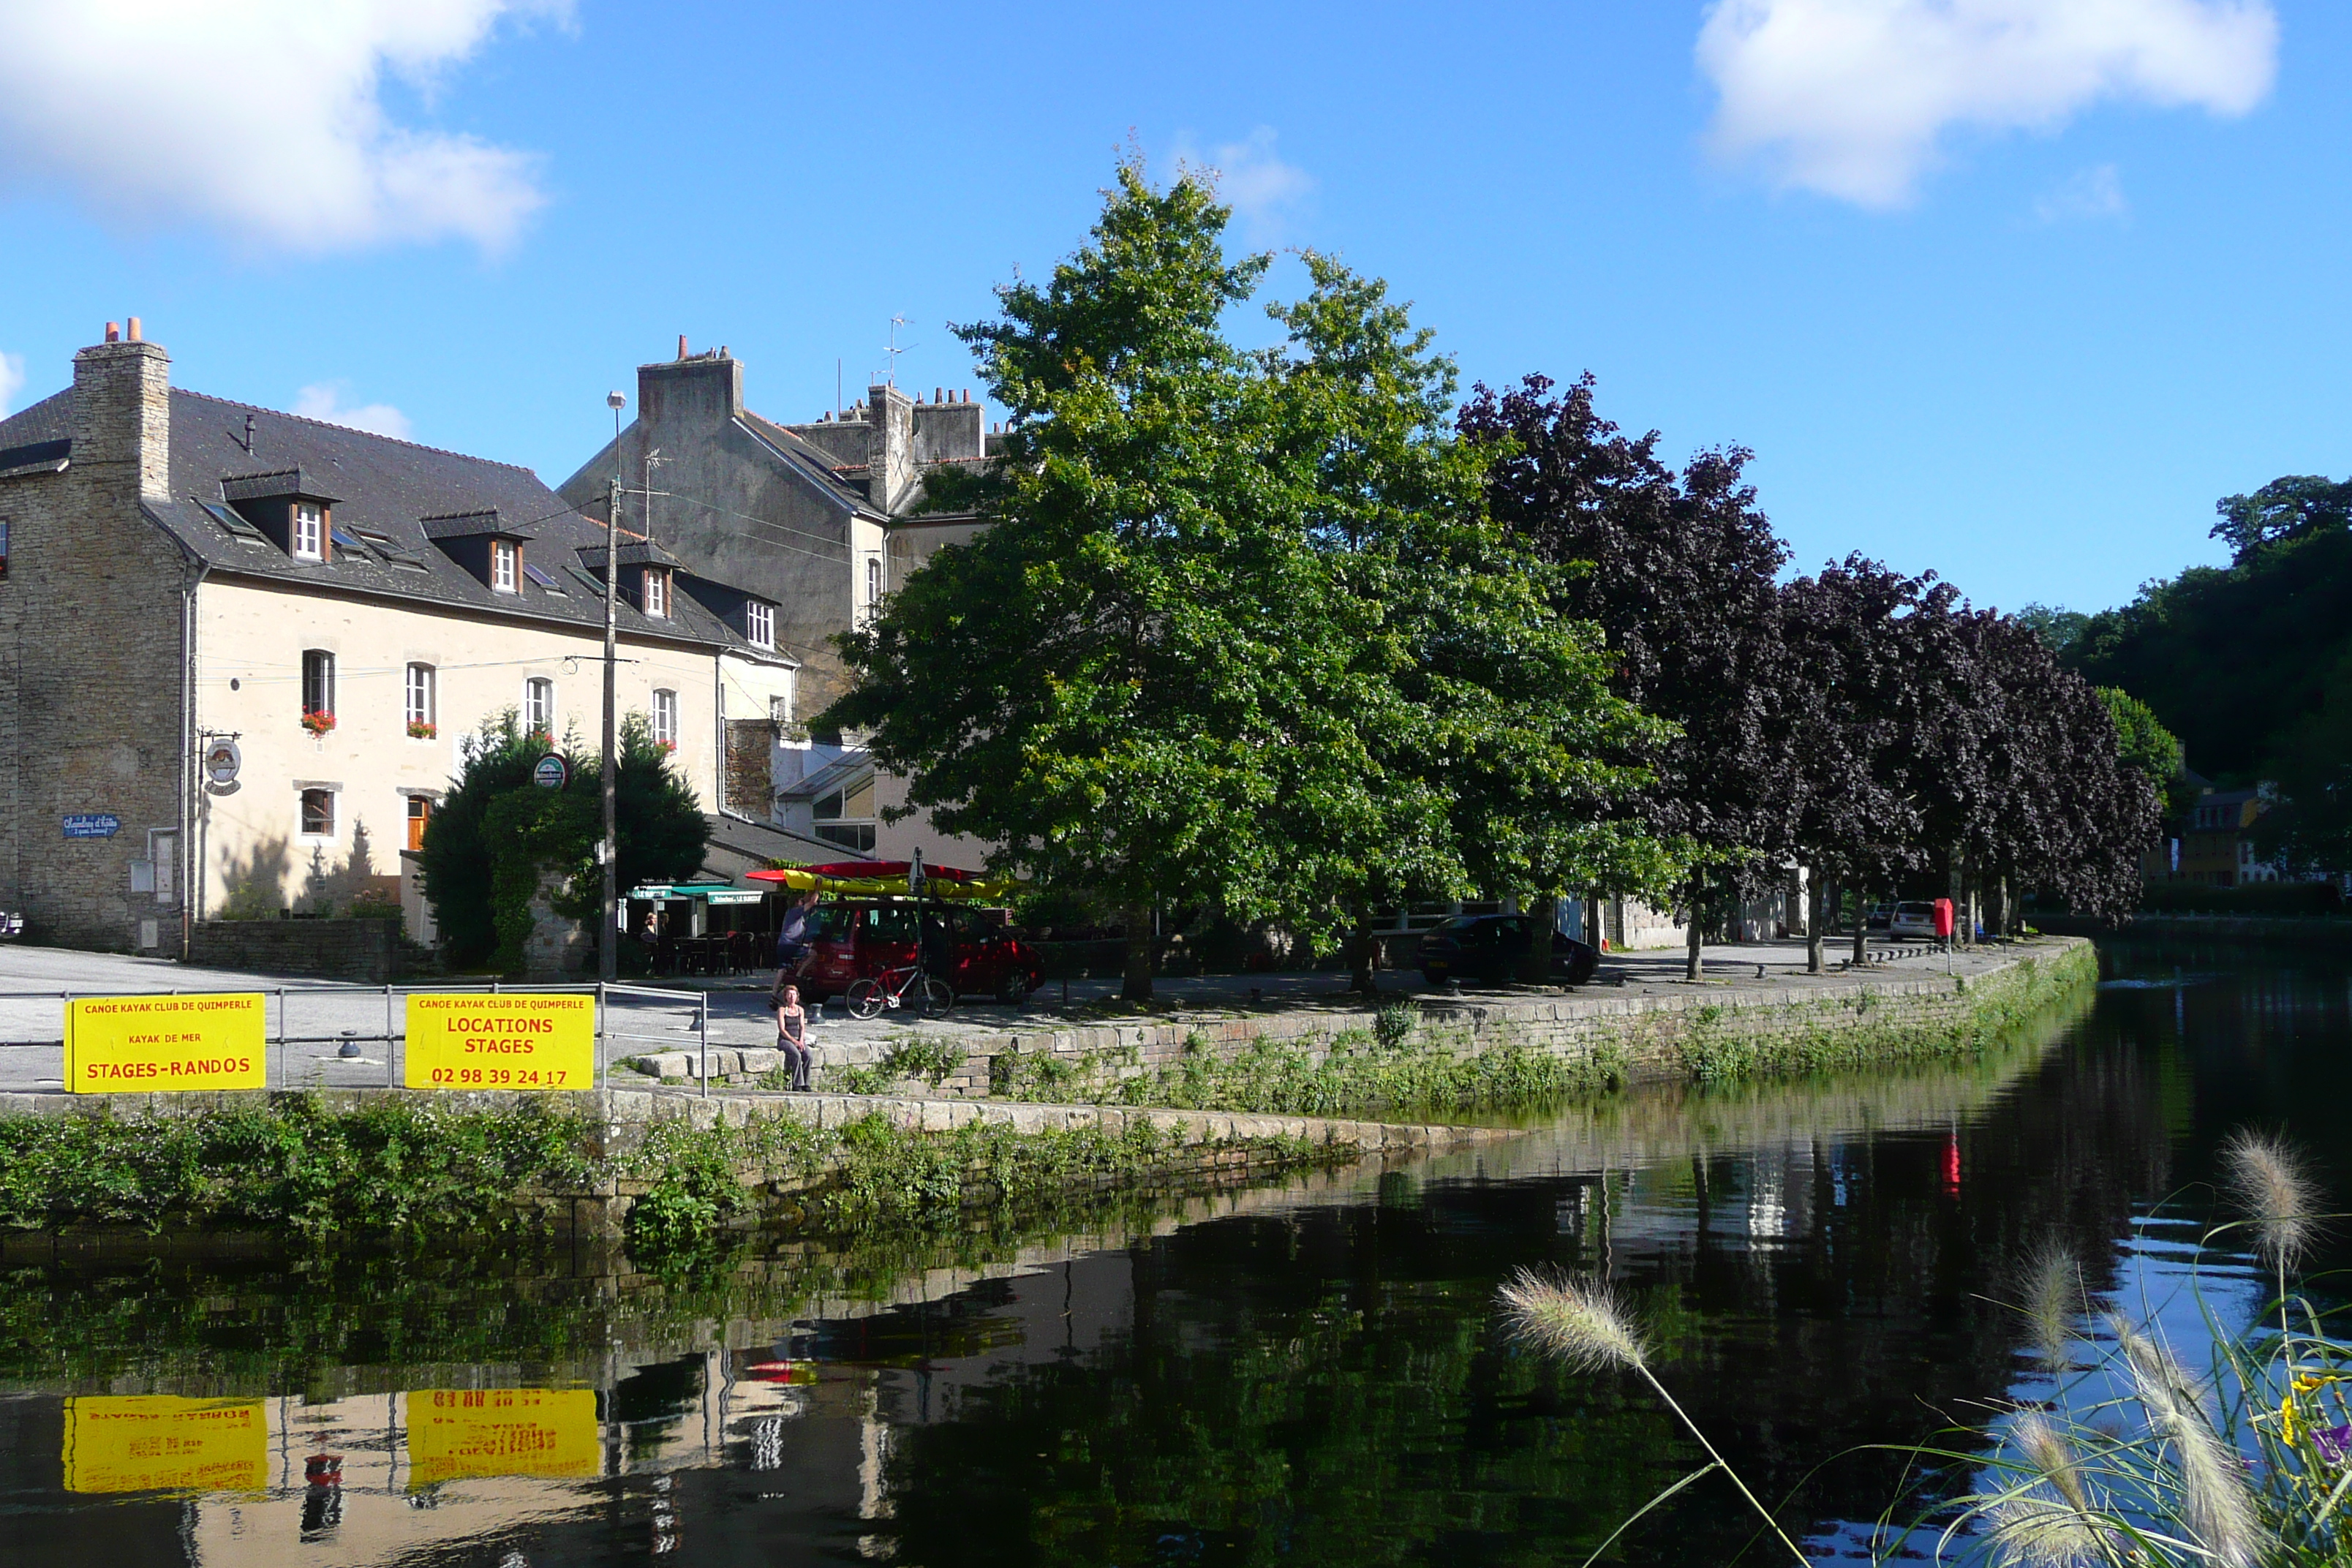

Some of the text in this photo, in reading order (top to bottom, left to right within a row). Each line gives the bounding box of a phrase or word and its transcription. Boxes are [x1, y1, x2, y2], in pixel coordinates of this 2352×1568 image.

[85, 1000, 252, 1014] CANOE KAYAK CLUB DE QUIMPERLE
[418, 1000, 584, 1011] CANOE KAYAK CLUB DE QUIMPERLE
[447, 1017, 553, 1033] LOCATIONS
[129, 1033, 201, 1044] KAYAK DE MER
[464, 1038, 534, 1054] STAGES
[86, 1058, 250, 1079] STAGES-RANDOS
[431, 1068, 567, 1085] 02 98 39 24 17
